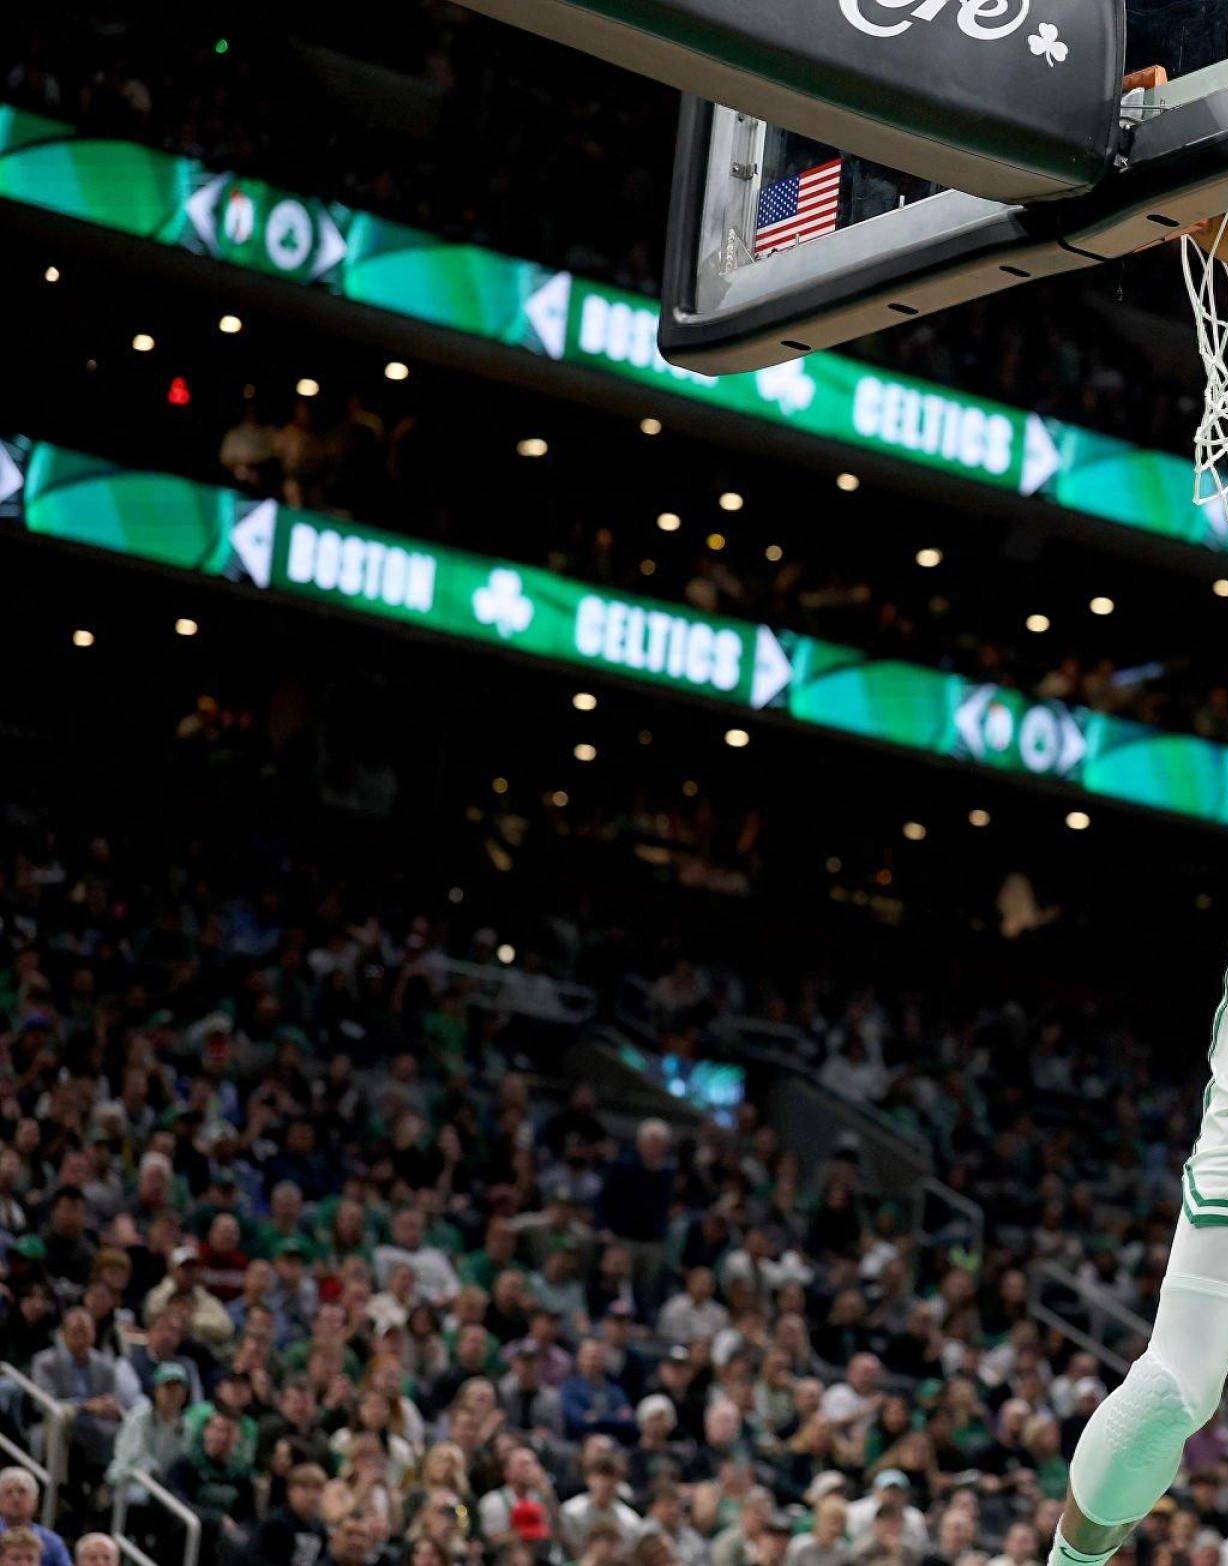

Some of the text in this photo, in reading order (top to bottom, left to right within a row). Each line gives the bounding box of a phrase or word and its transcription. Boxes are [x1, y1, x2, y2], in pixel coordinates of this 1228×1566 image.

[853, 375, 1013, 475] CELTICS
[287, 522, 742, 691] BOSTON CELTICS
